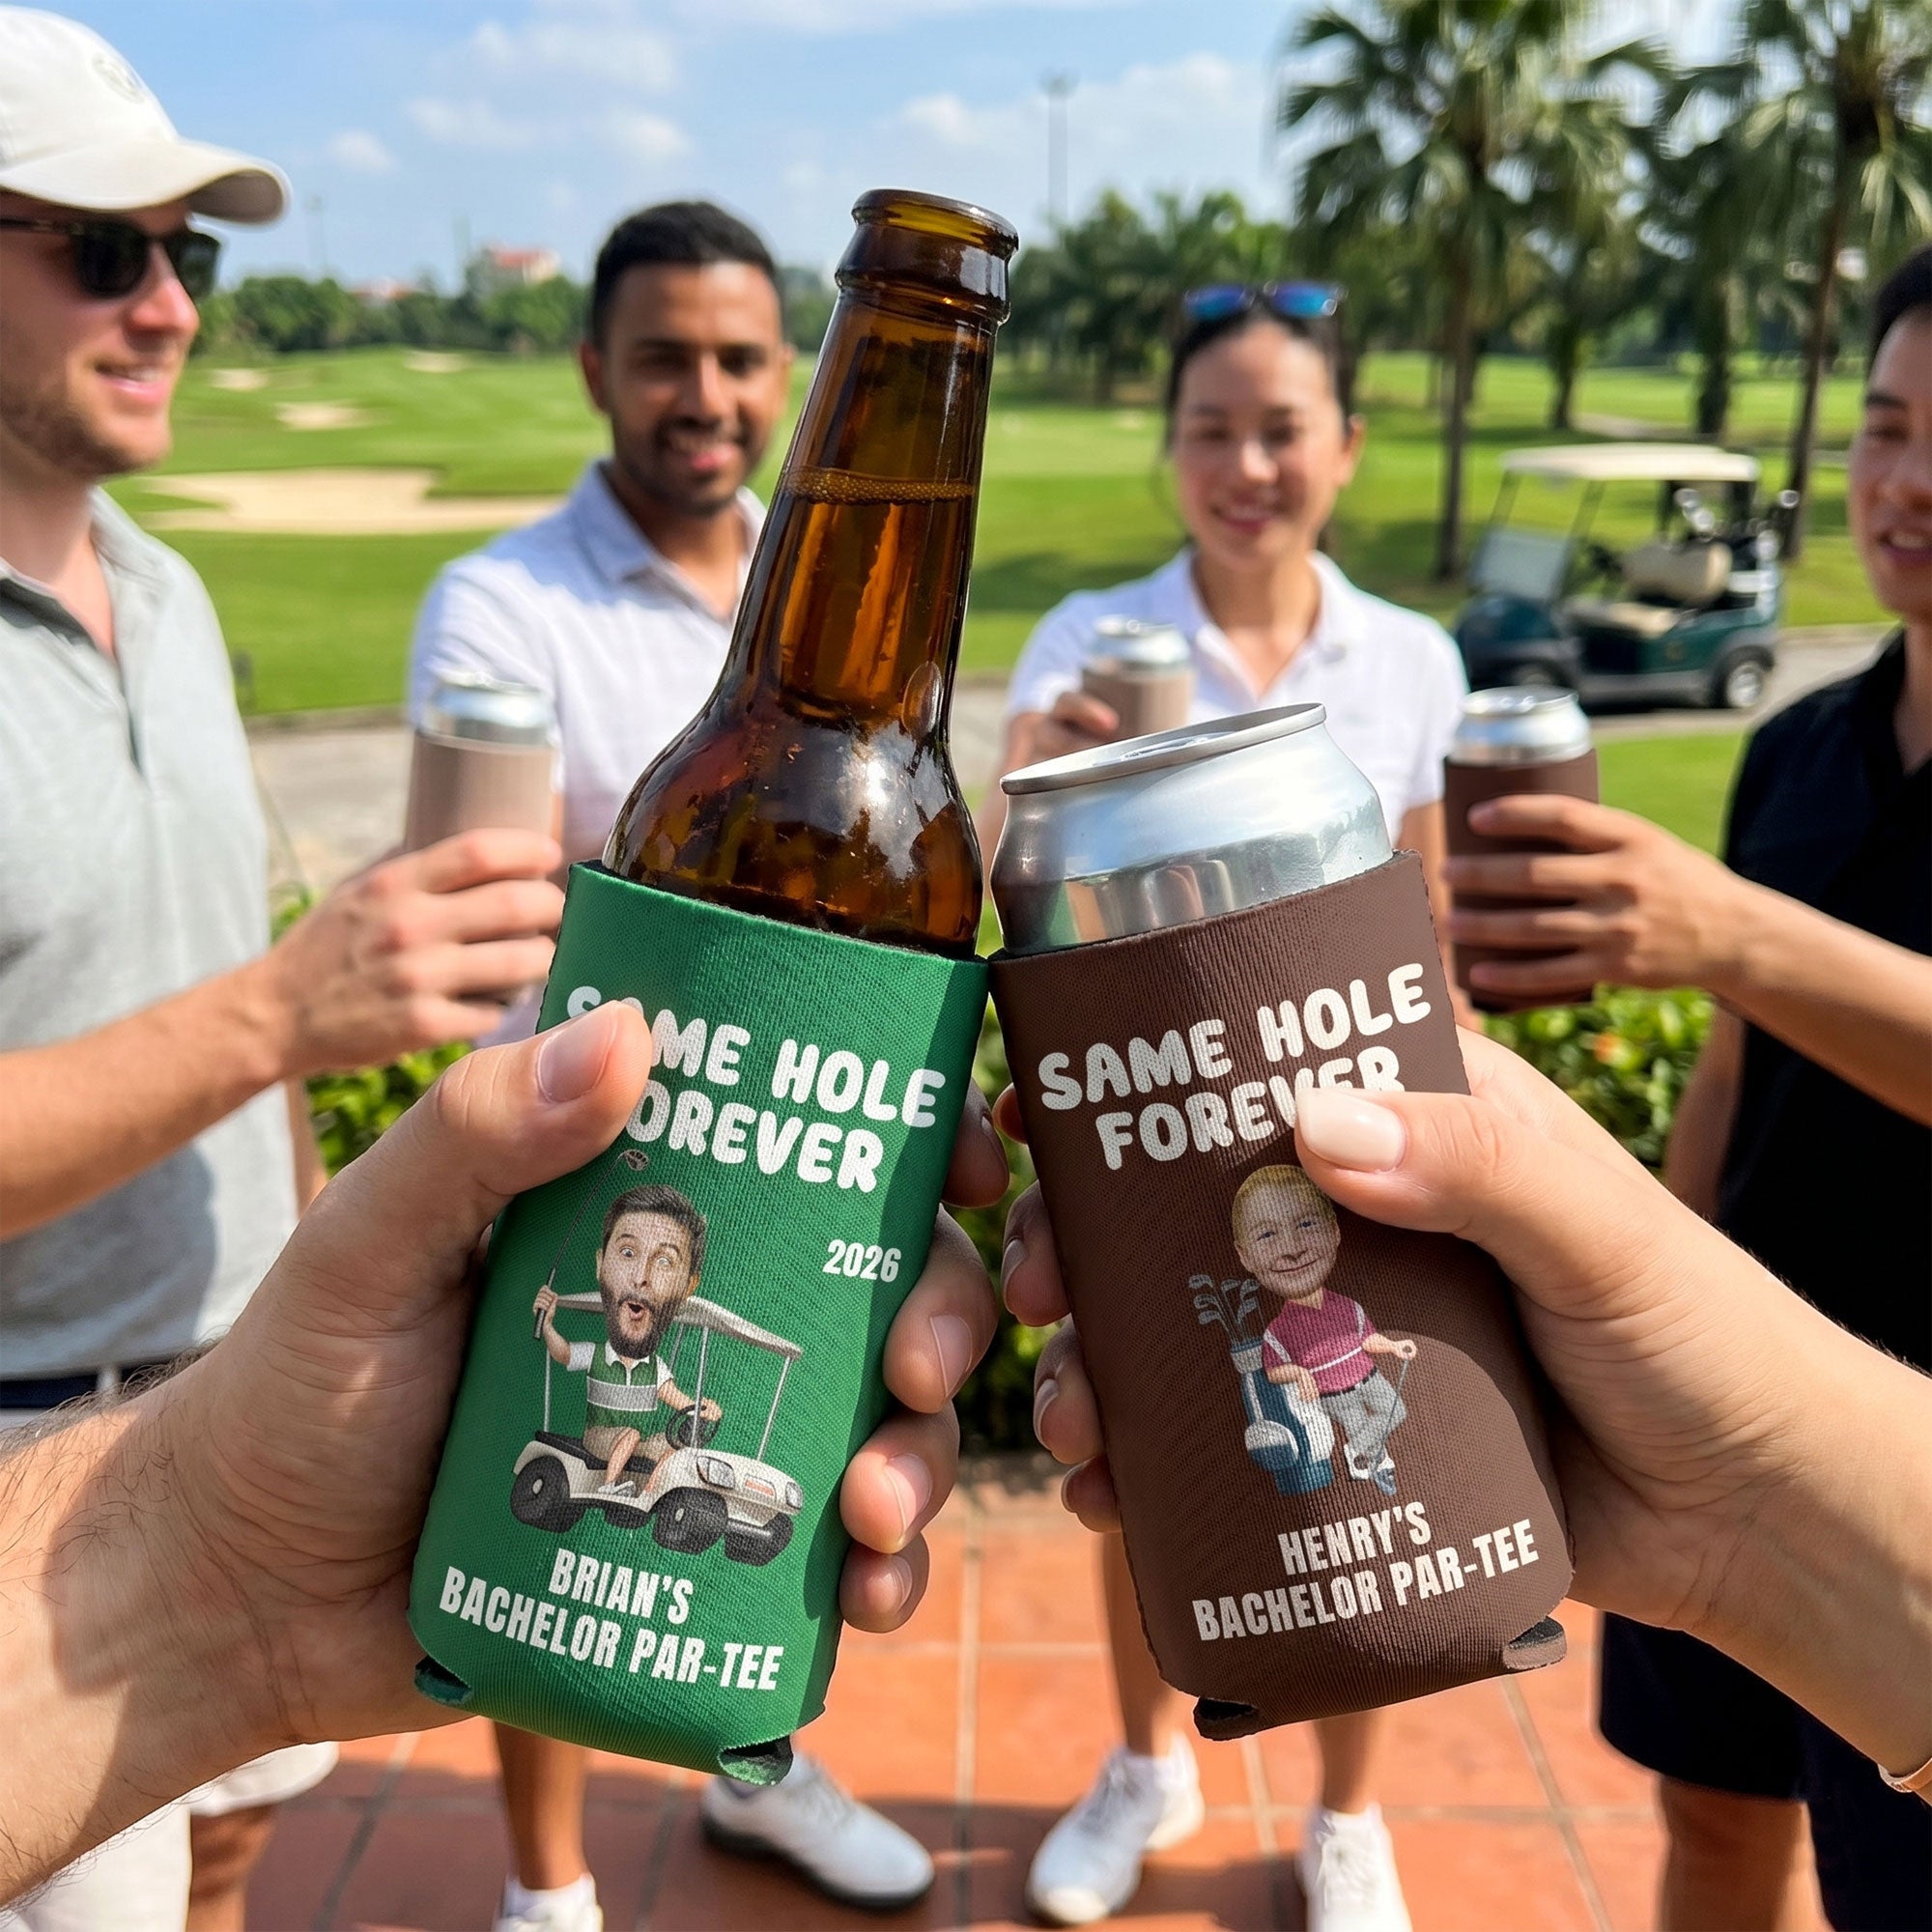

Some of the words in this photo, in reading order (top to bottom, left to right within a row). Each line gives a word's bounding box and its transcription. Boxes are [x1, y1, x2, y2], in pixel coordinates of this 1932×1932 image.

[566, 985, 751, 1086] ME
[773, 1038, 947, 1128] HOLE
[1037, 1018, 1233, 1110] SAME
[1257, 963, 1432, 1062] HOLE
[625, 1079, 884, 1193] OREVER
[822, 1238, 901, 1283] 2026
[548, 1548, 694, 1624] BRIAN'S
[1192, 1569, 1382, 1641] BACHELOR
[1390, 1519, 1539, 1606] PAR-TEE
[1277, 1501, 1432, 1576] HENRY'S
[439, 1566, 621, 1668] BACHELOR
[629, 1628, 783, 1690] PAR-TEE
